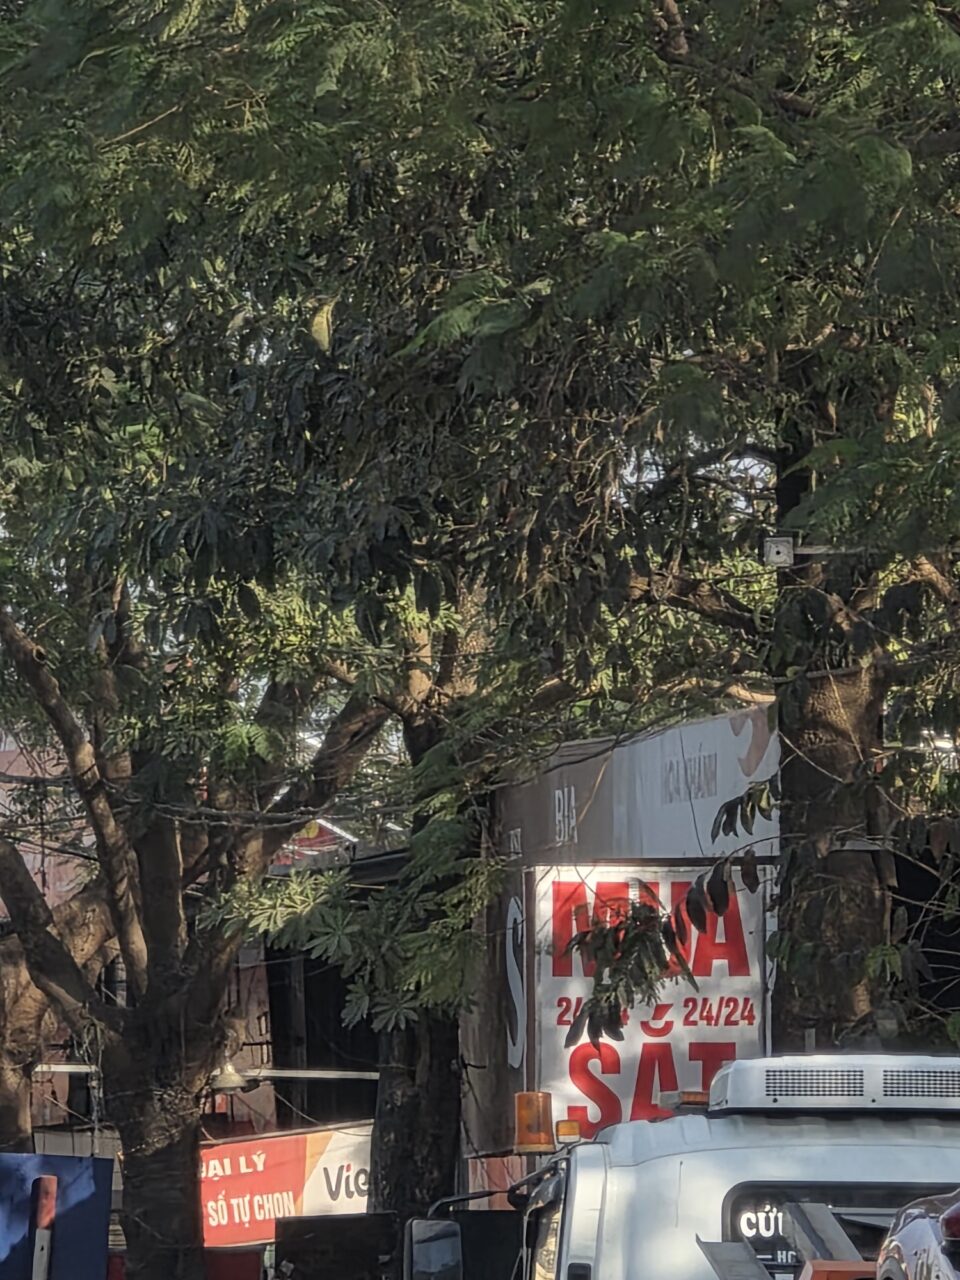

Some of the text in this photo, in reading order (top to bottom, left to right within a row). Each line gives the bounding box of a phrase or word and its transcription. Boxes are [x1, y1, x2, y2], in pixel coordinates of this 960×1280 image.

[555, 785, 578, 844] BIA
[682, 996, 756, 1027] 24/24
[567, 1003, 737, 1140] SẮT
[238, 1151, 267, 1174] LÝ
[206, 1189, 230, 1228] SỐ
[230, 1193, 252, 1228] TỰ
